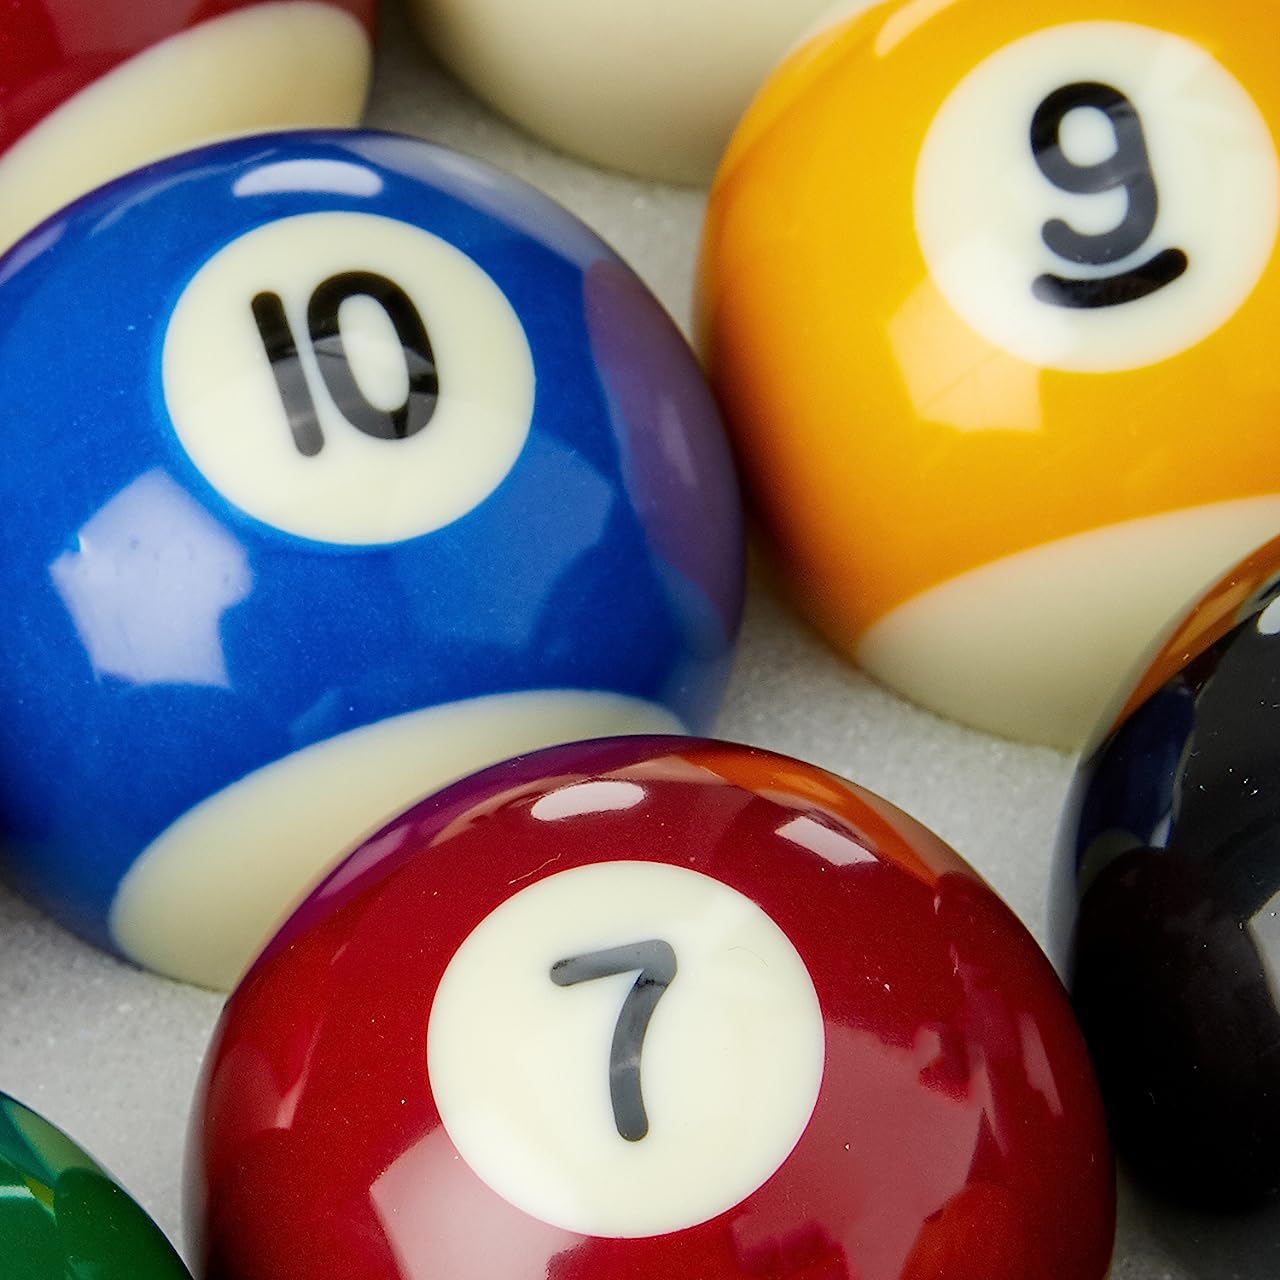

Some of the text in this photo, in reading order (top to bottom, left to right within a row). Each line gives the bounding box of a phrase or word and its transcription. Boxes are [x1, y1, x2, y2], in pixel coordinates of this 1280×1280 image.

[1029, 81, 1159, 266] 9
[250, 270, 440, 457] 10
[551, 940, 677, 1142] 7
